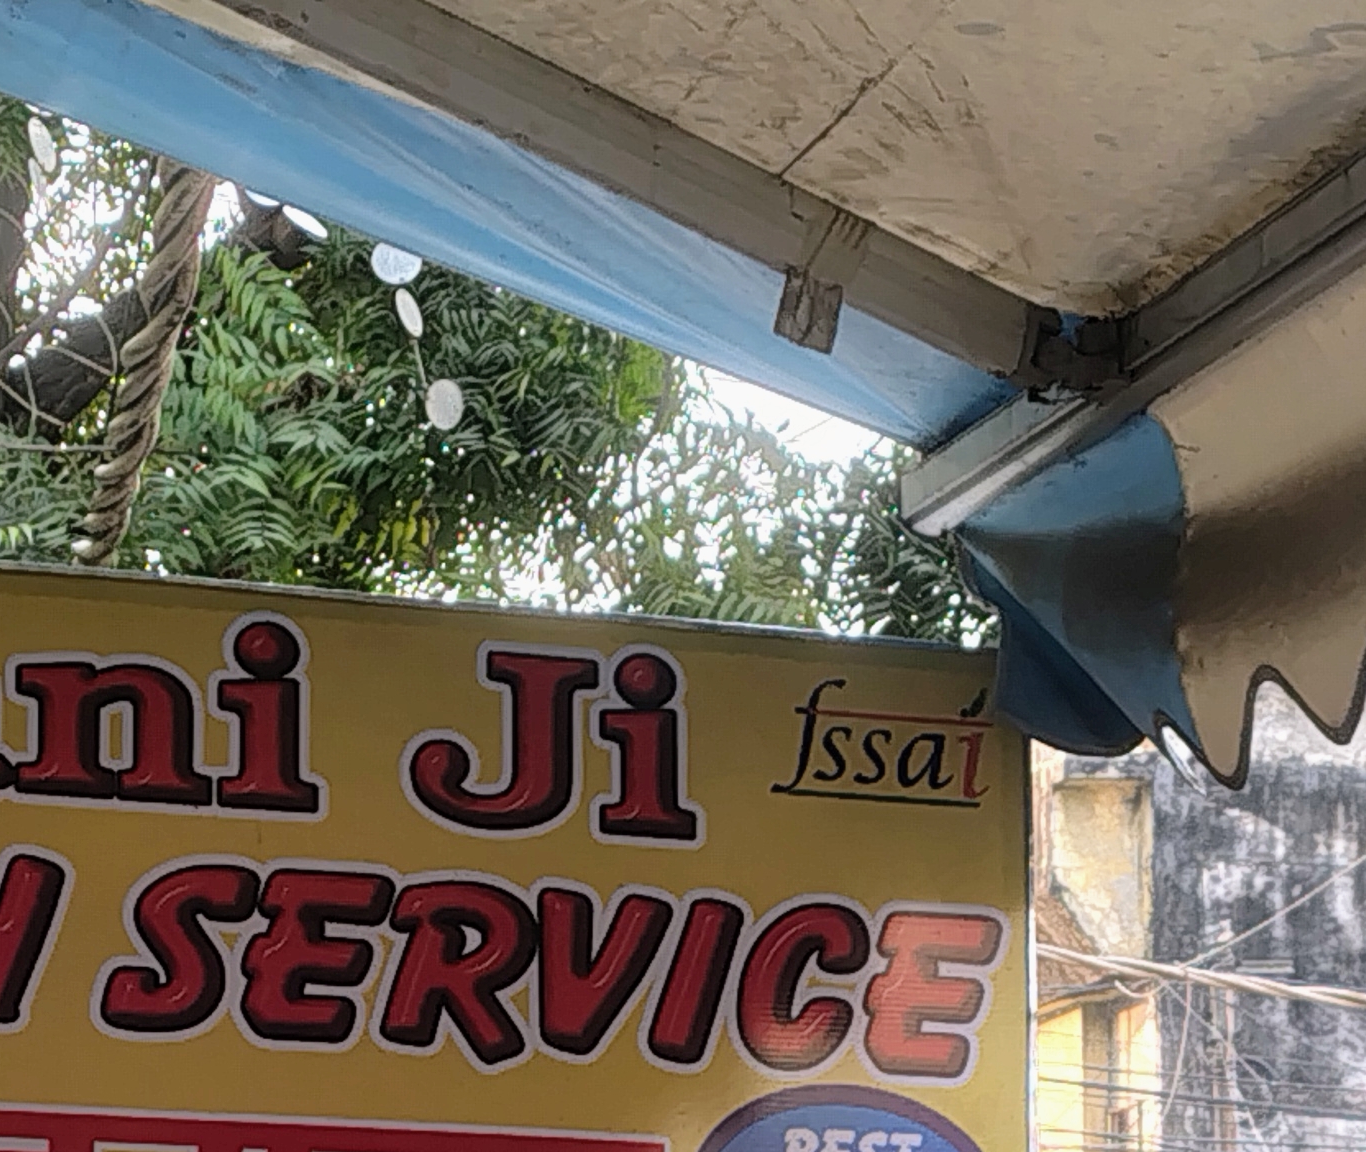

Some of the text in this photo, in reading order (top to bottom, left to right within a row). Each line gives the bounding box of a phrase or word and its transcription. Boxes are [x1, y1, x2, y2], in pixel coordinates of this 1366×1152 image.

[407, 645, 701, 842] Ji
[771, 678, 993, 808] fssai
[98, 862, 1002, 1079] SERVICE
